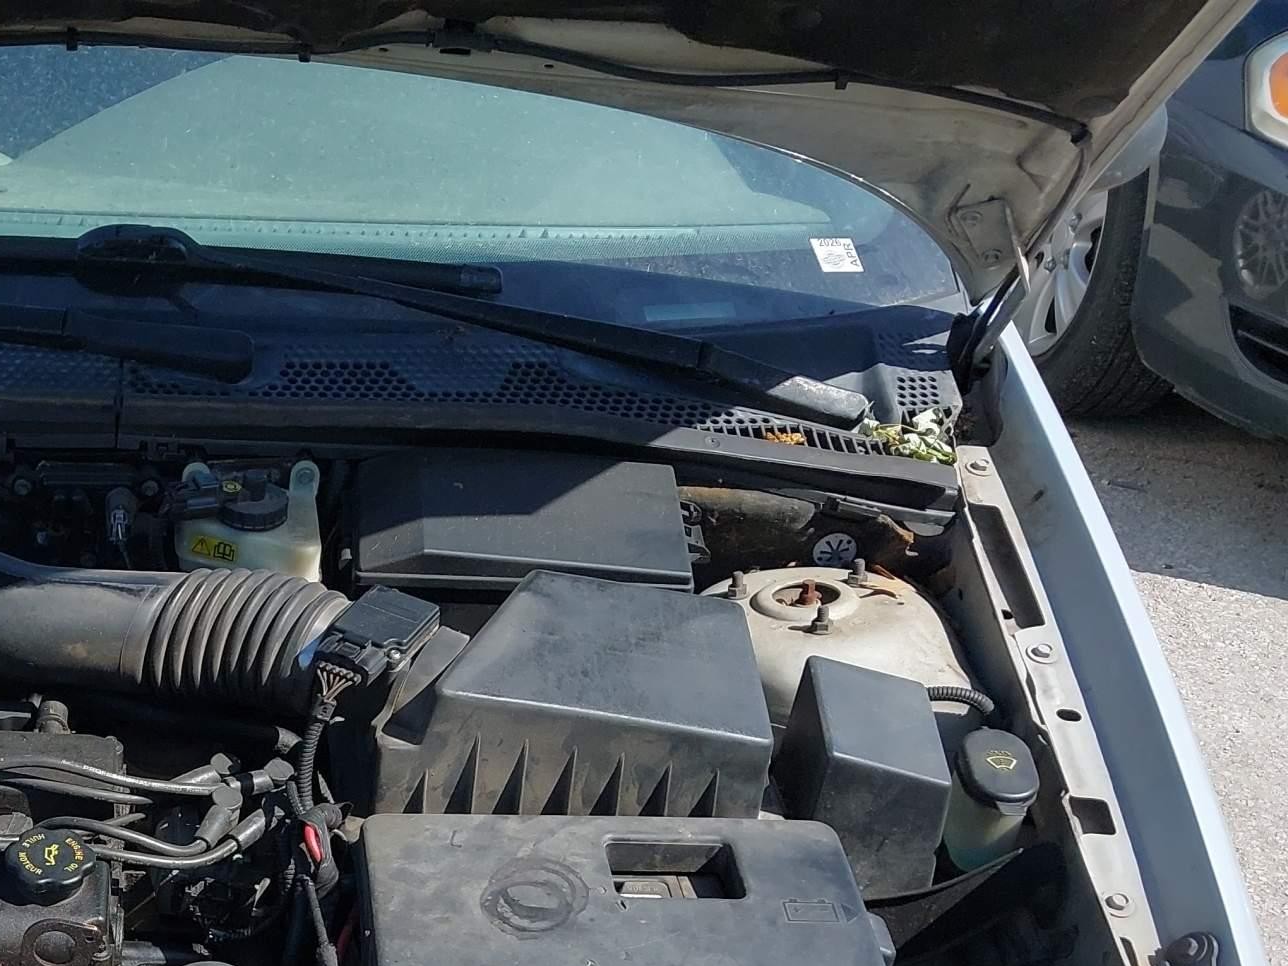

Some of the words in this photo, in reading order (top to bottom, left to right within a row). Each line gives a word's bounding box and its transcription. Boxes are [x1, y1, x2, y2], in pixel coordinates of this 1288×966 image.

[843, 243, 860, 267] APR
[22, 833, 46, 848] HUILE
[65, 838, 84, 861] ENGINE
[18, 851, 43, 875] MOTEUR
[64, 863, 78, 872] OIL
